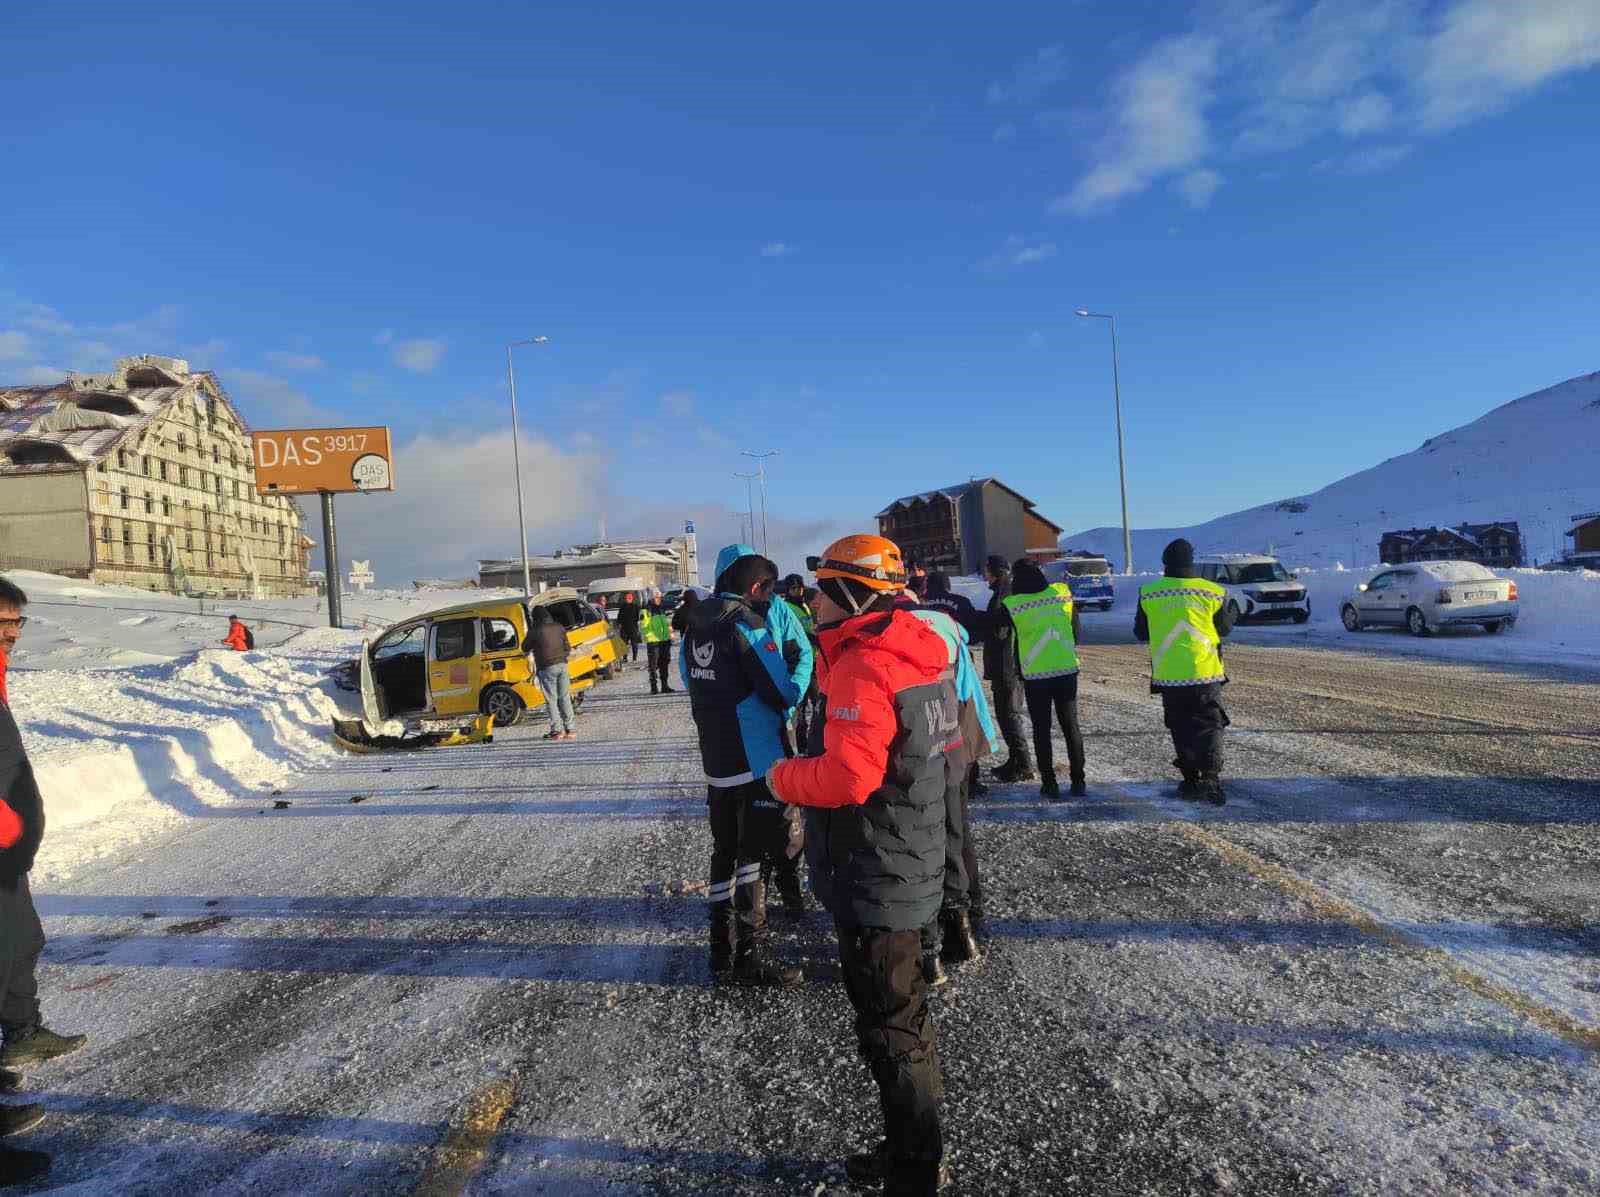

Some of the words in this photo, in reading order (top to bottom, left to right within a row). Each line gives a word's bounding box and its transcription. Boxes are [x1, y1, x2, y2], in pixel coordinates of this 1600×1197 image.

[258, 436, 322, 468] DAS
[324, 434, 368, 452] 3917
[360, 463, 385, 476] DAS
